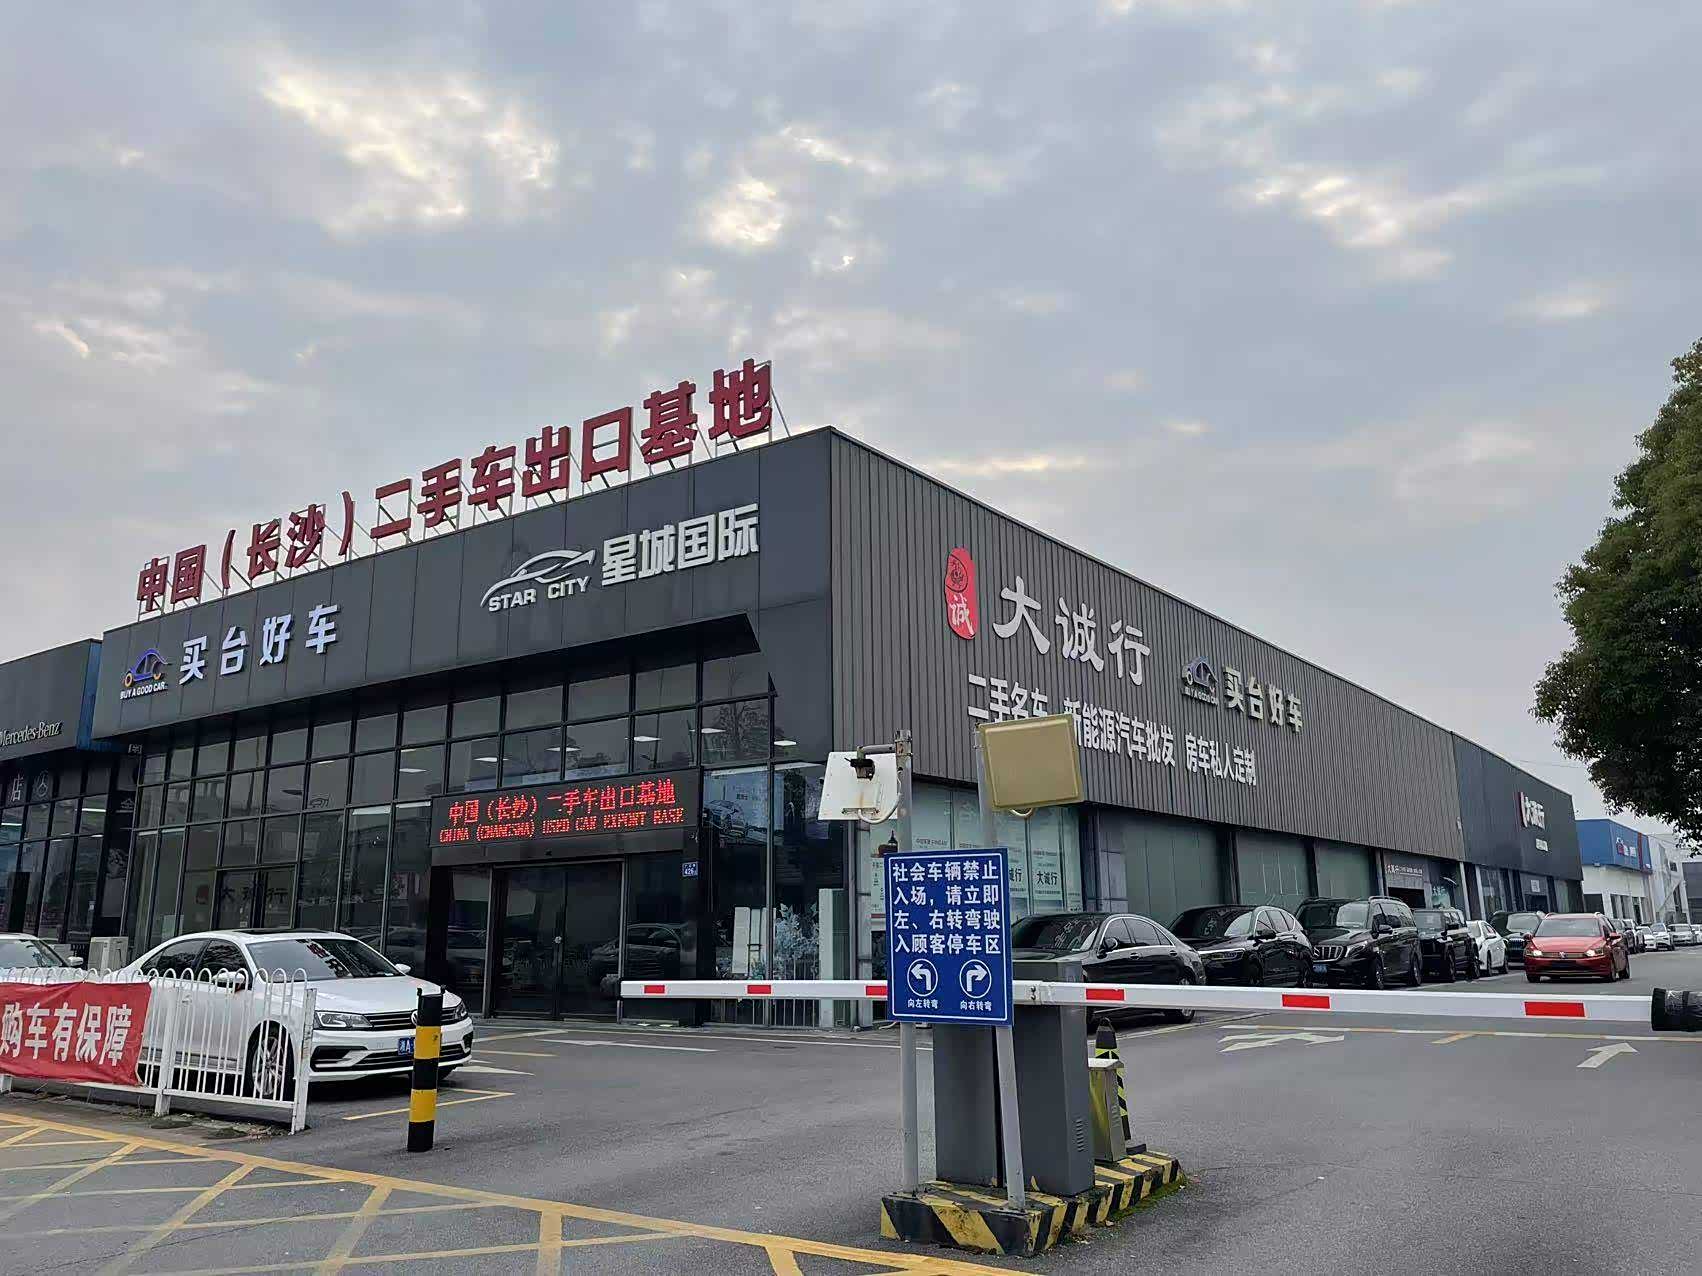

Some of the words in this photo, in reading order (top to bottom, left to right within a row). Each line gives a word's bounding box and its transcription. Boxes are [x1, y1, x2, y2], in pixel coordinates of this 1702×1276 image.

[601, 503, 759, 586] 星城国际
[488, 588, 537, 612] STAR
[547, 576, 590, 599] CITY
[179, 604, 338, 685] 买台好车
[992, 575, 1151, 686] 大诚行
[120, 689, 131, 699] BUY
[137, 685, 152, 696] GOOD
[153, 681, 166, 692] CAR
[1223, 666, 1303, 733] 买台好车
[0, 721, 61, 747] Mercedes-Benz
[1185, 731, 1257, 786] 房车私人定制
[440, 828, 469, 842] CHINA
[542, 818, 570, 833] USED
[575, 816, 597, 830] CAR
[603, 811, 647, 828] EXPORT
[653, 807, 684, 824] BASE
[893, 860, 999, 882] 社会车辆禁止
[894, 884, 999, 906] 入场，请立即
[894, 908, 1001, 930] 左、右转弯驶
[895, 933, 1002, 955] 入顾客停车区
[907, 998, 939, 1009] 向左转弯
[960, 1000, 992, 1012] 向右转弯
[0, 1002, 132, 1067] 购车有保障
